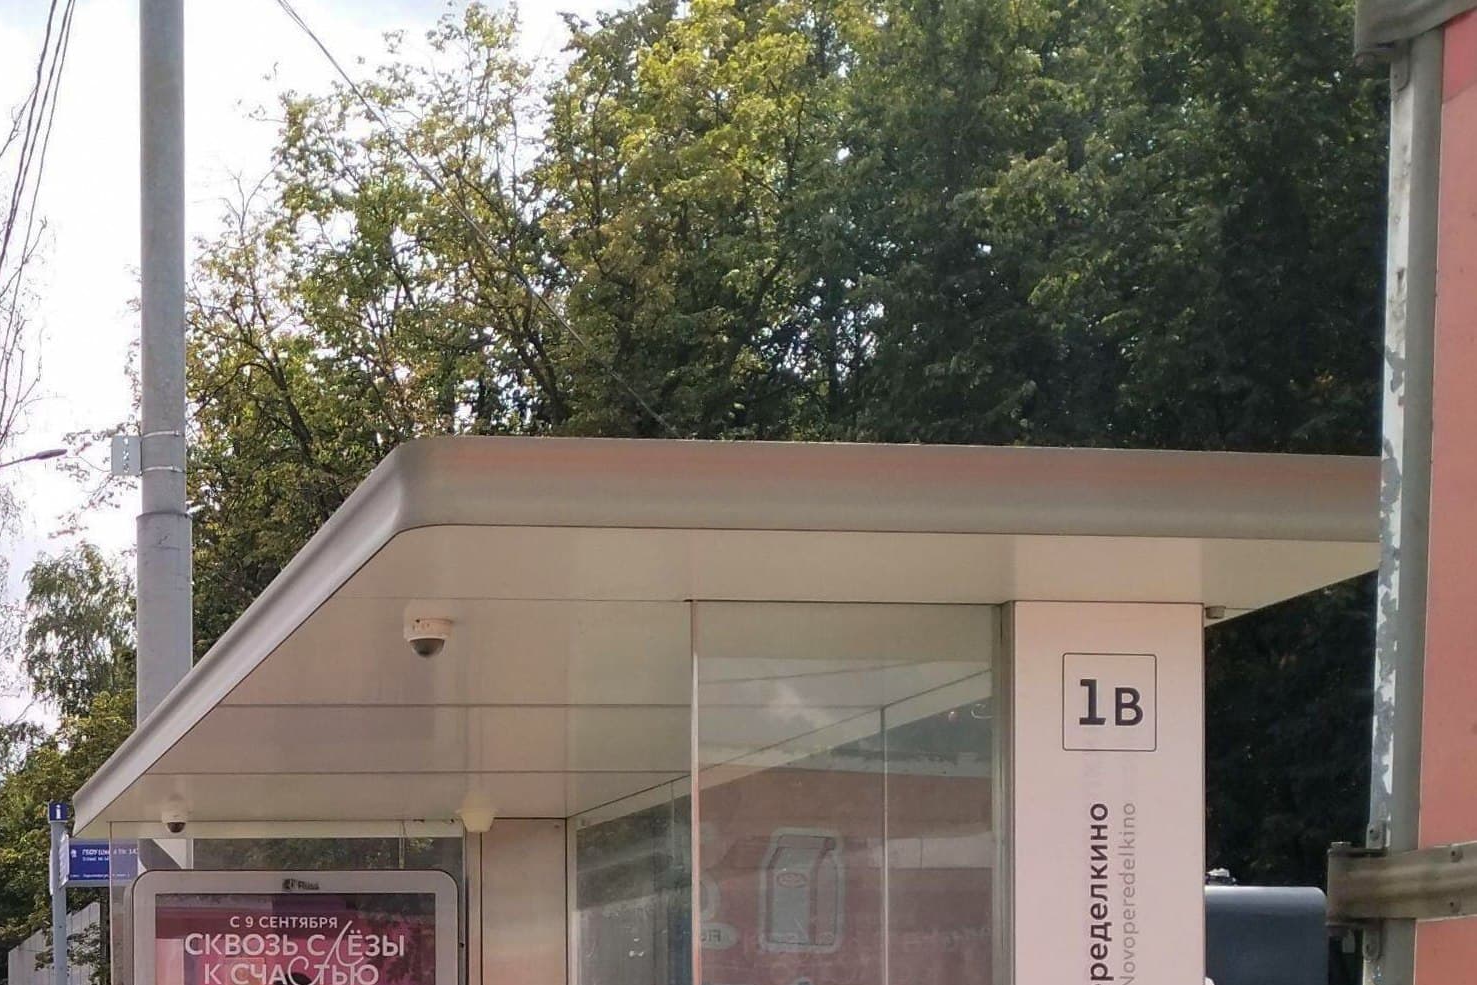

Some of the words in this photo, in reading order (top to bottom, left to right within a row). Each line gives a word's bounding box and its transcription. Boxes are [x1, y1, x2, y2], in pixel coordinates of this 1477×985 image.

[229, 915, 241, 929] С
[245, 915, 254, 929] 9
[258, 915, 338, 929] СЕНТЯБРЯ
[184, 932, 298, 957] СКВОЗЬ
[307, 920, 405, 968] СЛЁЗЫ
[204, 963, 222, 985] К
